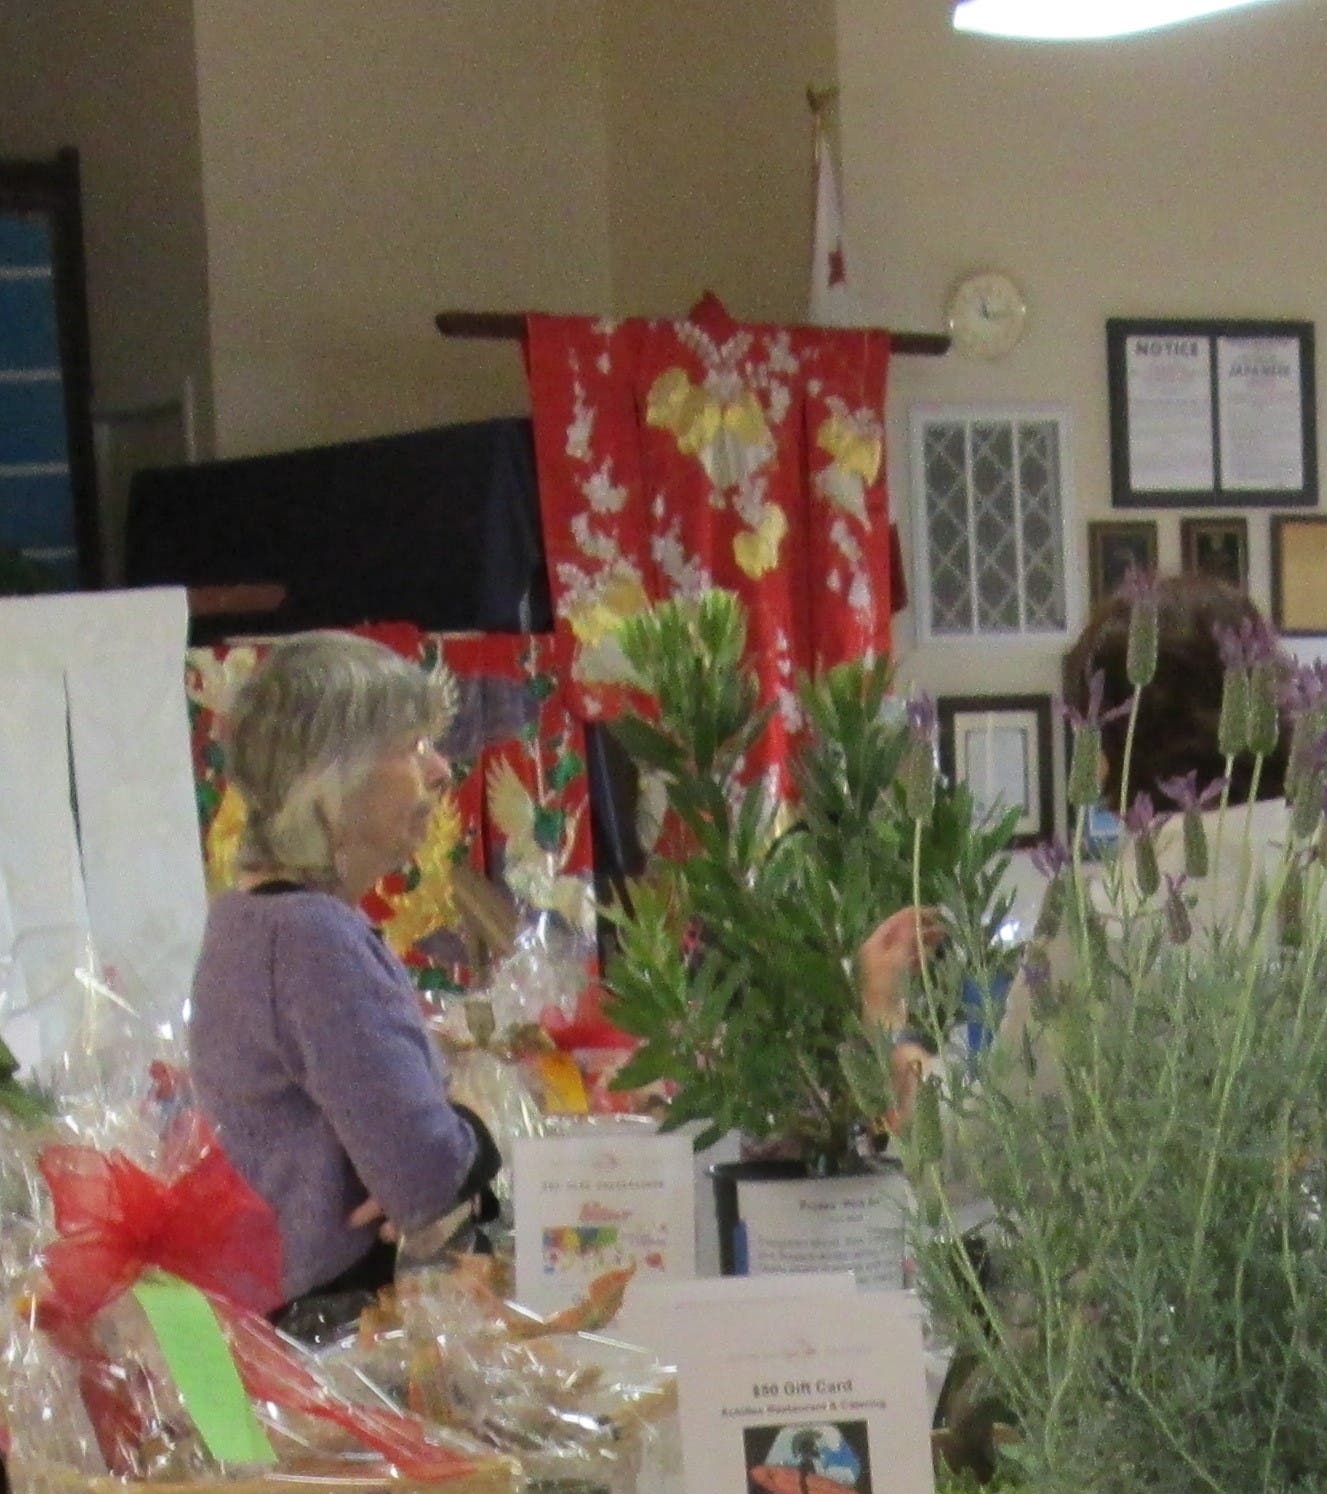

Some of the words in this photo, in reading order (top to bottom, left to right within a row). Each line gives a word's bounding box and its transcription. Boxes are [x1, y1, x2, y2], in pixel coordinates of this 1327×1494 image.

[1135, 340, 1199, 357] NOTICE
[783, 1379, 811, 1397] Gift
[815, 1378, 853, 1395] Card
